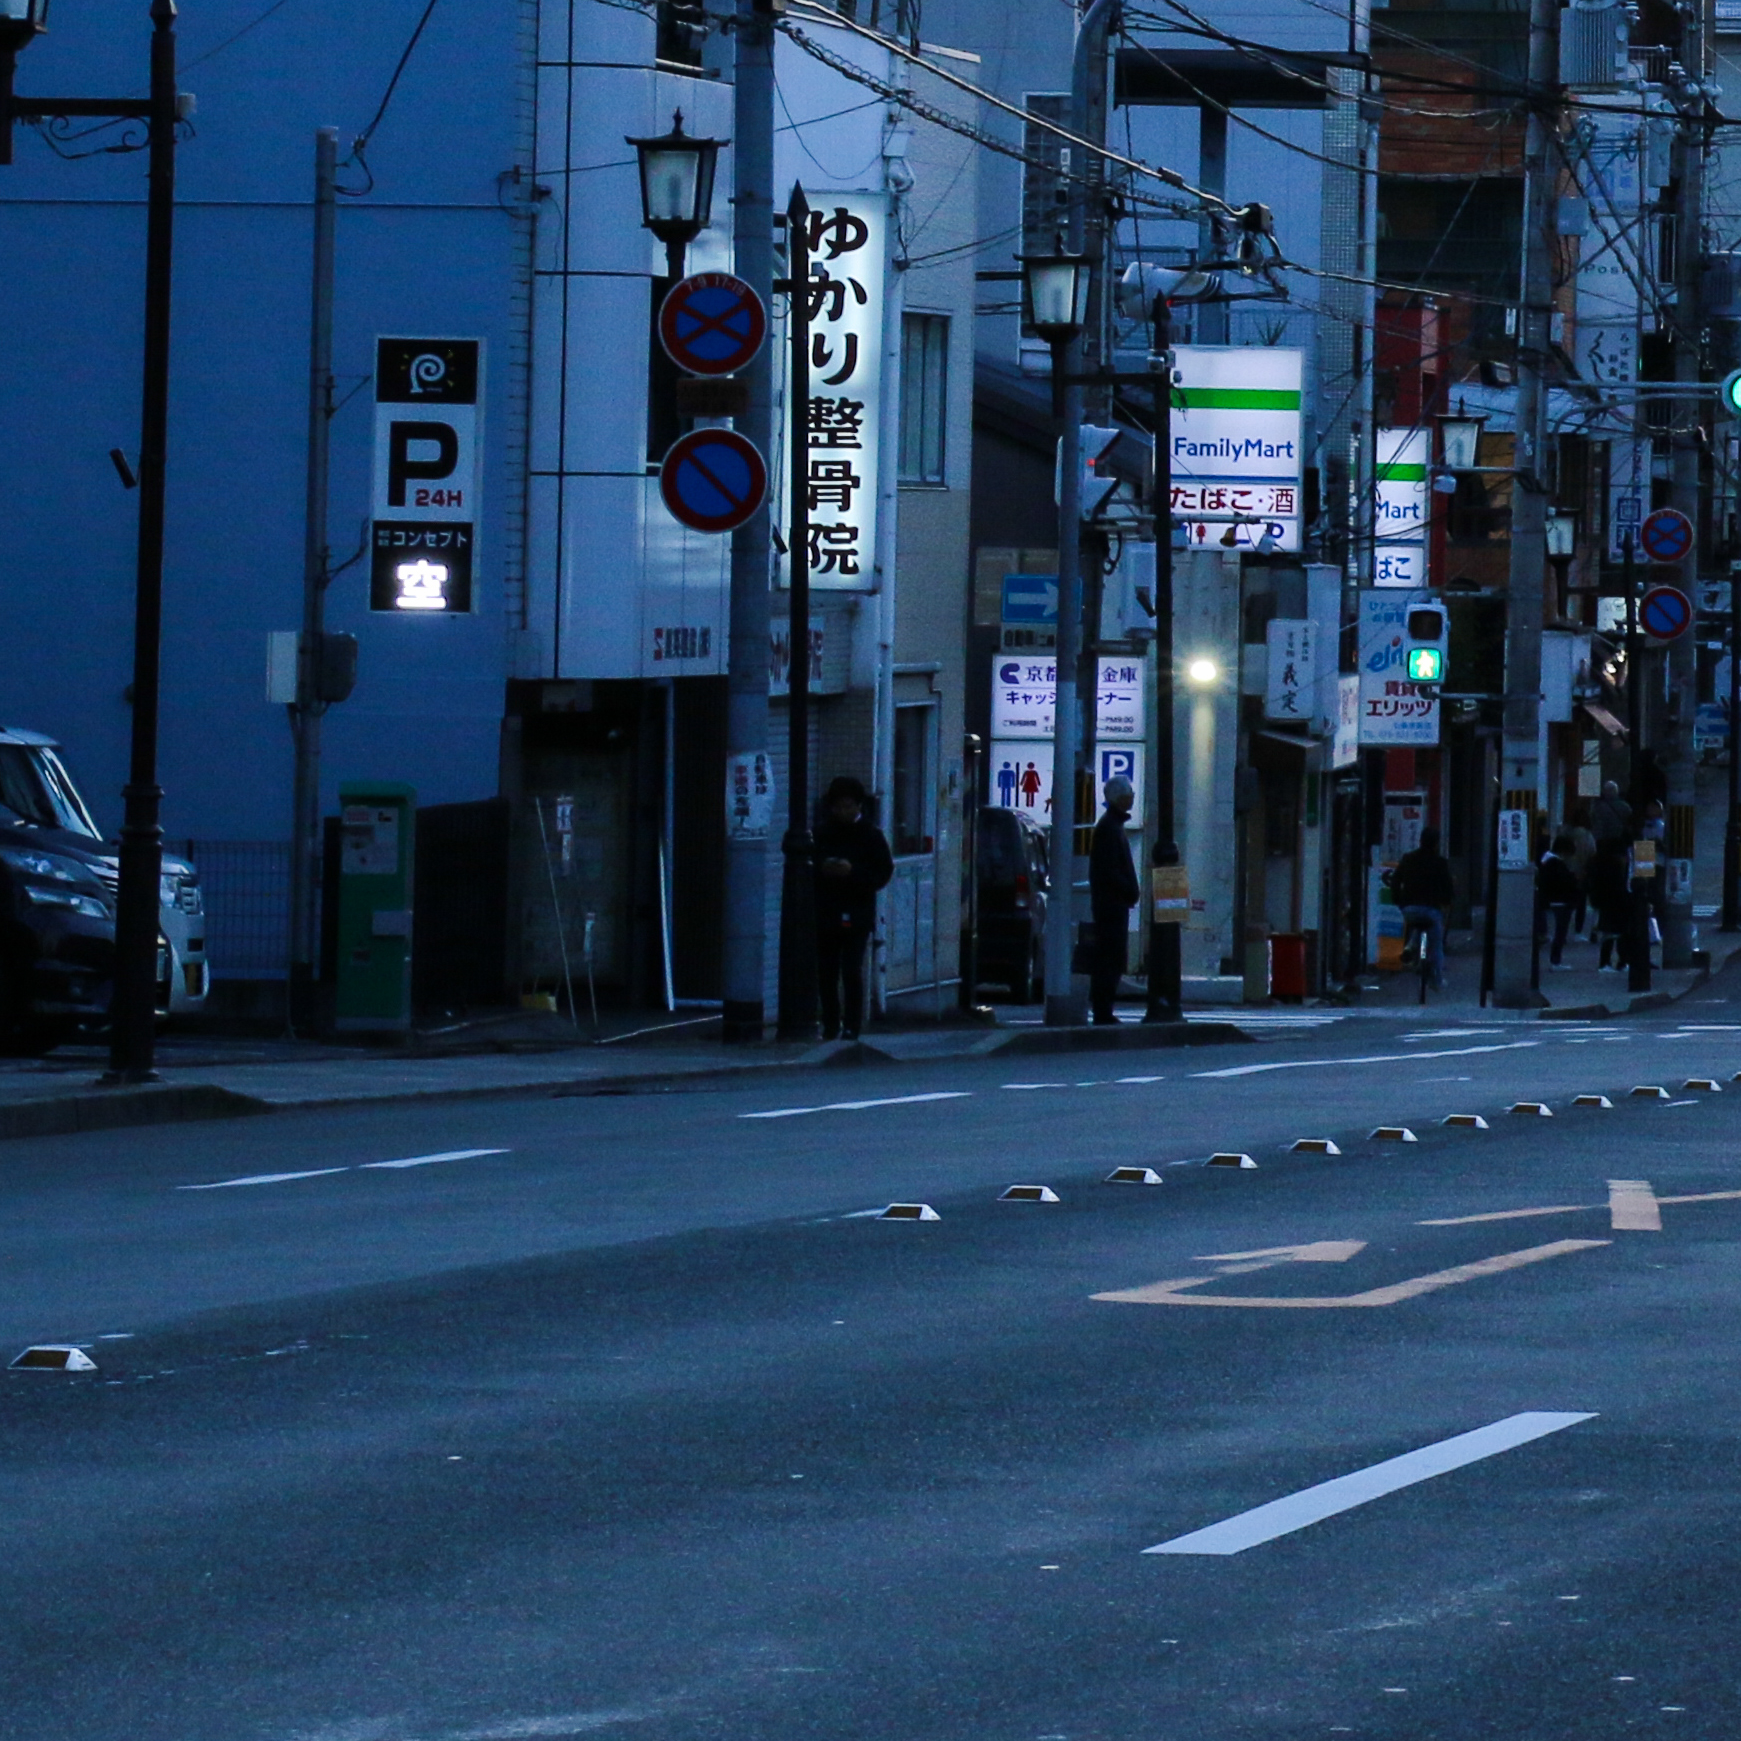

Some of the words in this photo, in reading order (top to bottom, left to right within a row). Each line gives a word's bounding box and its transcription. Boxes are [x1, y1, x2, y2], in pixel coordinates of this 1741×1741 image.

[807, 206, 868, 575] ゆかり整骨院
[1174, 437, 1295, 462] FamilyMart
[387, 420, 459, 507] P
[415, 488, 464, 508] 24H
[393, 529, 468, 548] コンセプト
[394, 558, 450, 610] 空
[1366, 699, 1433, 718] エリッツ
